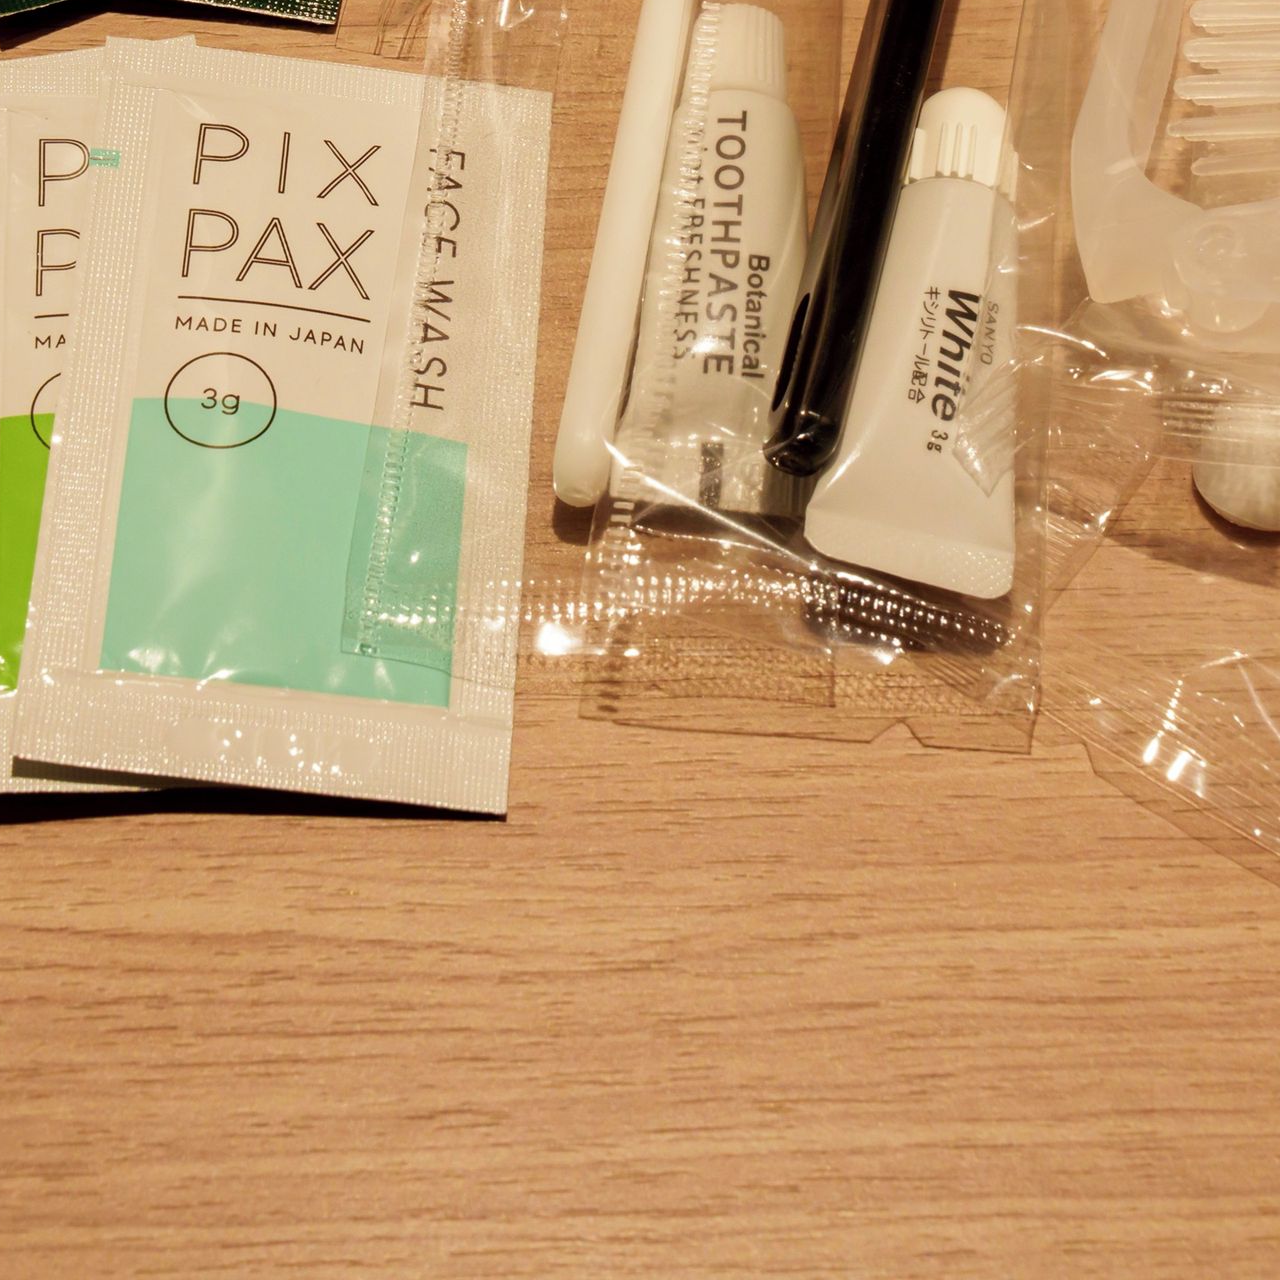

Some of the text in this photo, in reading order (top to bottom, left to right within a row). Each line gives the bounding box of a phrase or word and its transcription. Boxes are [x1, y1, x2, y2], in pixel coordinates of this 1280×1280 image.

[193, 122, 382, 207] PIX
[181, 208, 375, 301] PAX
[410, 148, 466, 412] FACE WASH
[703, 110, 748, 376] TOOTHPASTE
[35, 334, 67, 349] MA
[175, 316, 364, 355] MADE IN JAPAN
[741, 254, 771, 380] Botanical
[908, 286, 941, 404] キシリトール配合
[931, 289, 981, 422] White
[980, 301, 1000, 366] SANYO
[201, 387, 240, 415] 3g
